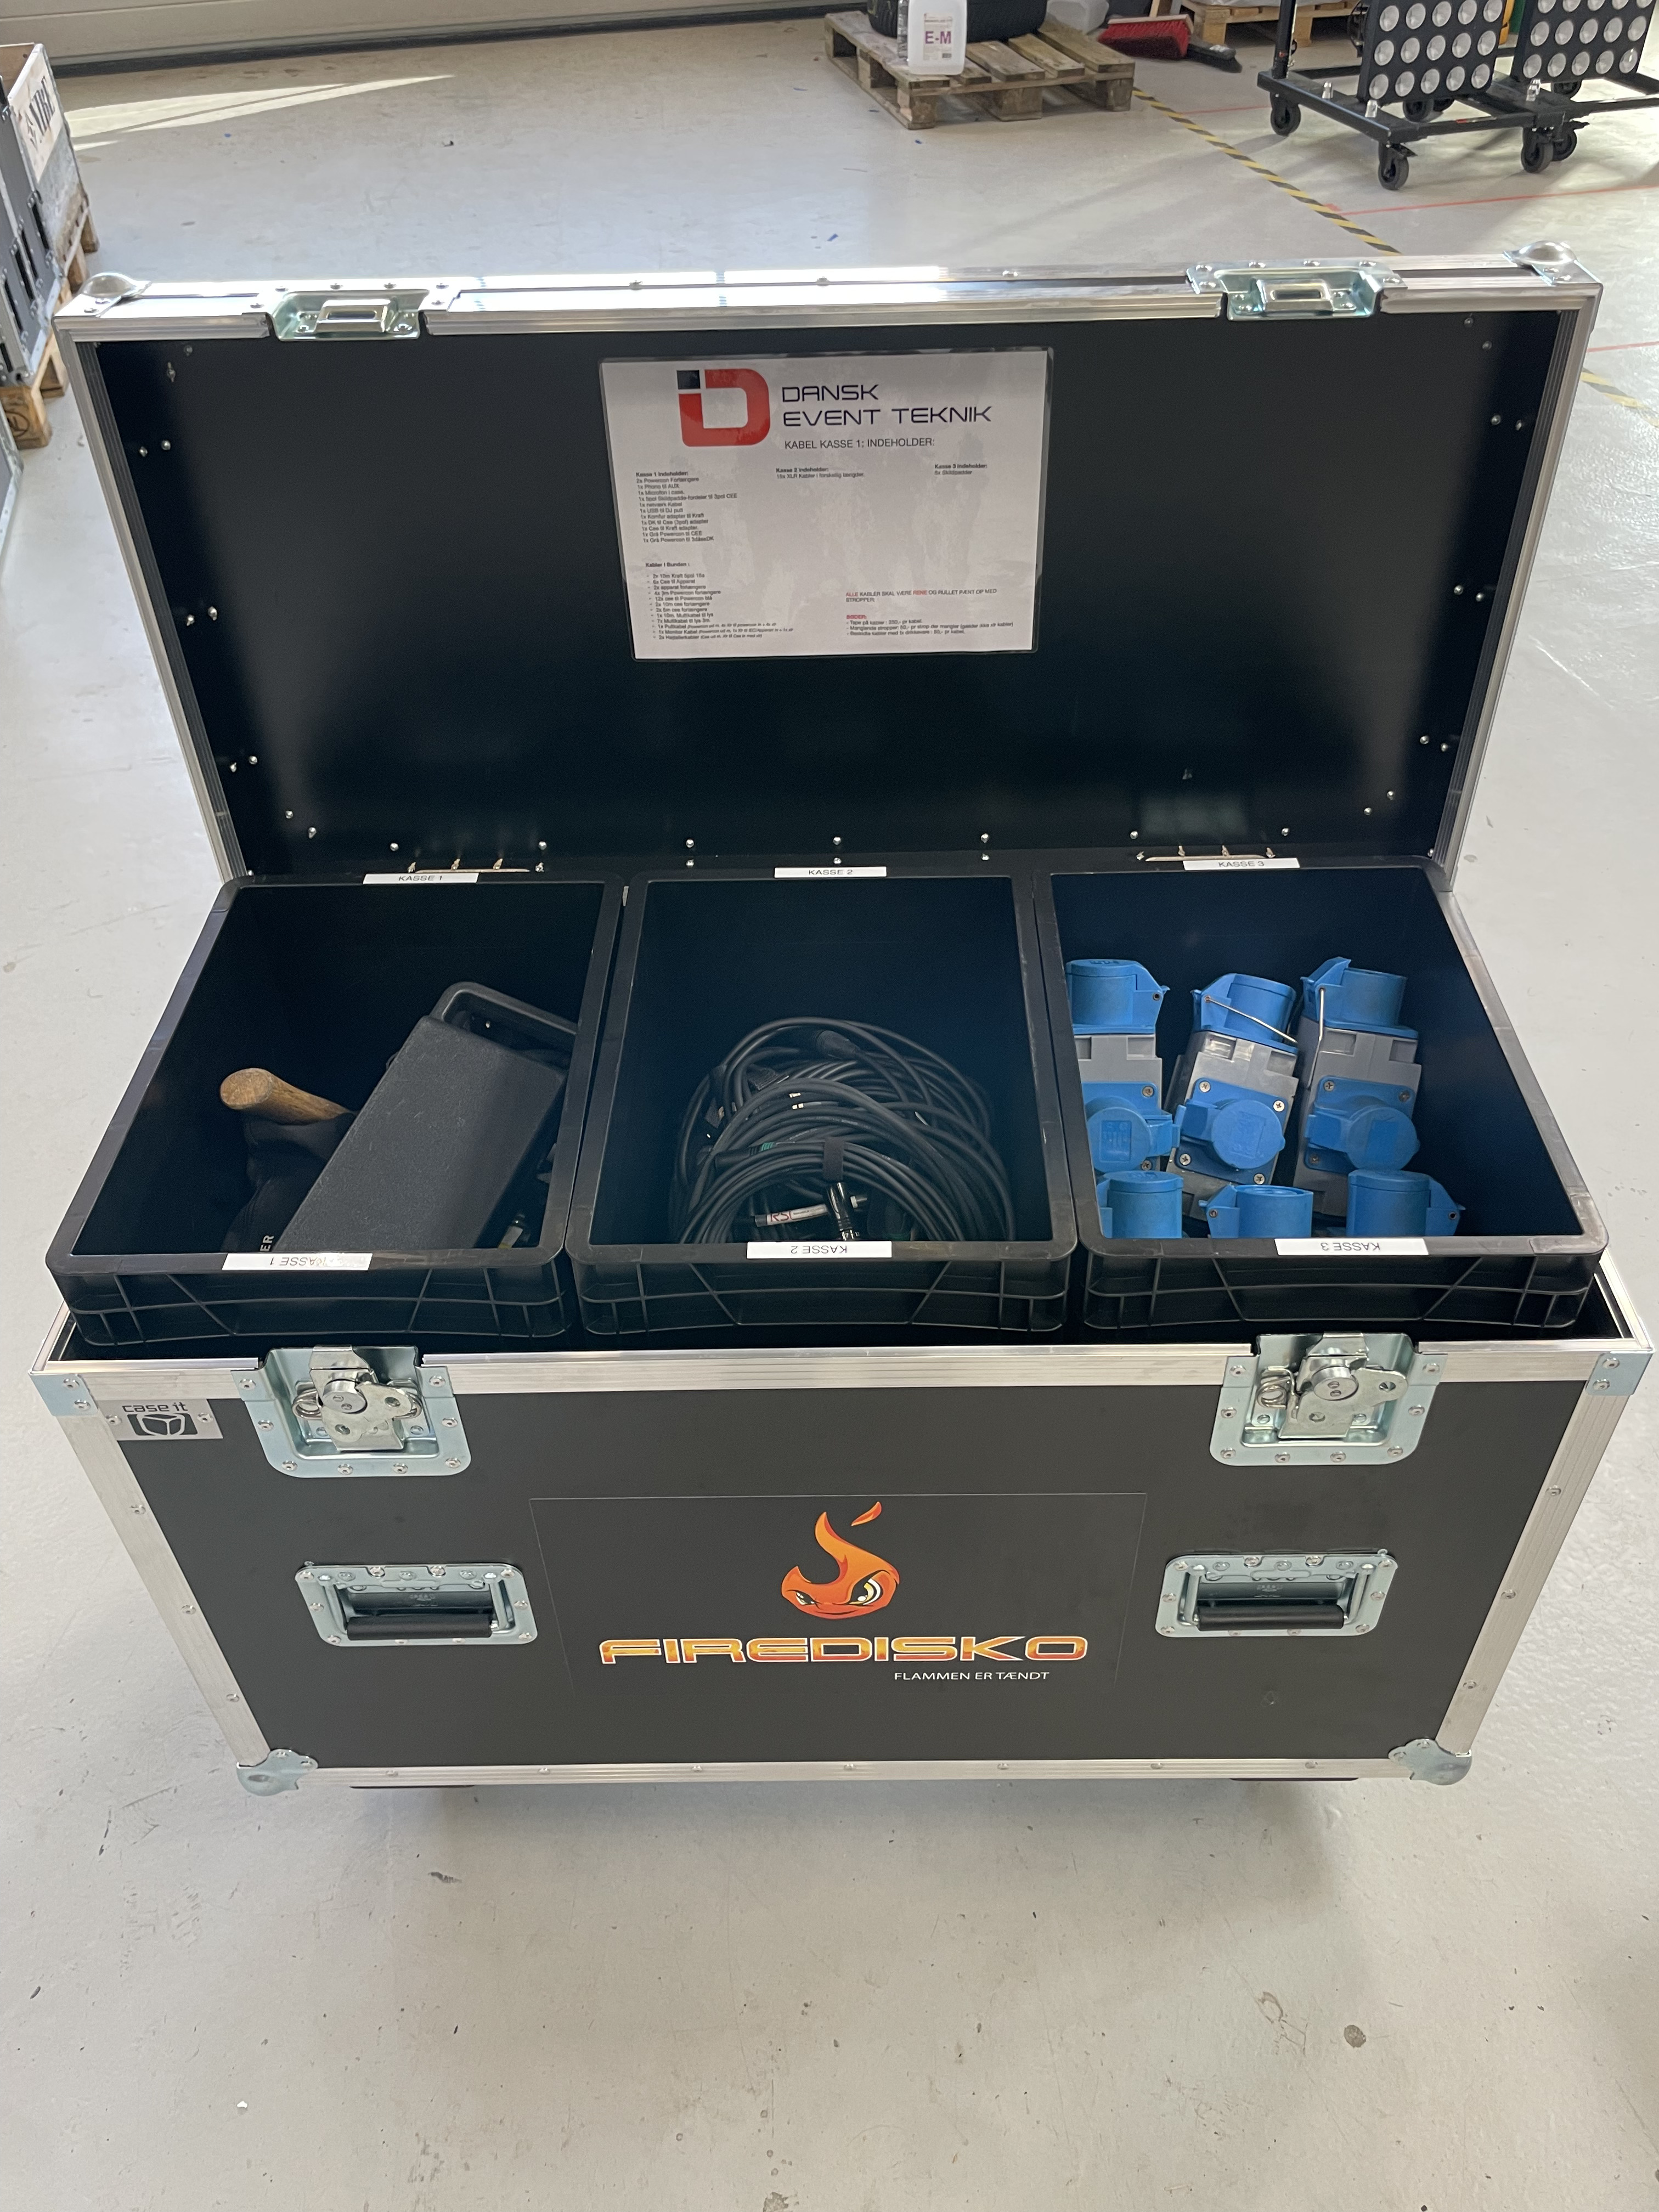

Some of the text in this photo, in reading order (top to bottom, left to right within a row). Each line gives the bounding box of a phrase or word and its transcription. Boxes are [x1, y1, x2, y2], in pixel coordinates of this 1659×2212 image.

[926, 31, 951, 44] E-M
[782, 385, 879, 402] DANSK
[783, 406, 992, 426] EVENT TEKNIK
[785, 438, 935, 449] KABEL KASSE 1: INDEHOLDER:
[1321, 1243, 1380, 1251] KASSE 3
[173, 1402, 188, 1411] it
[599, 1636, 1088, 1664] FIREDISKO
